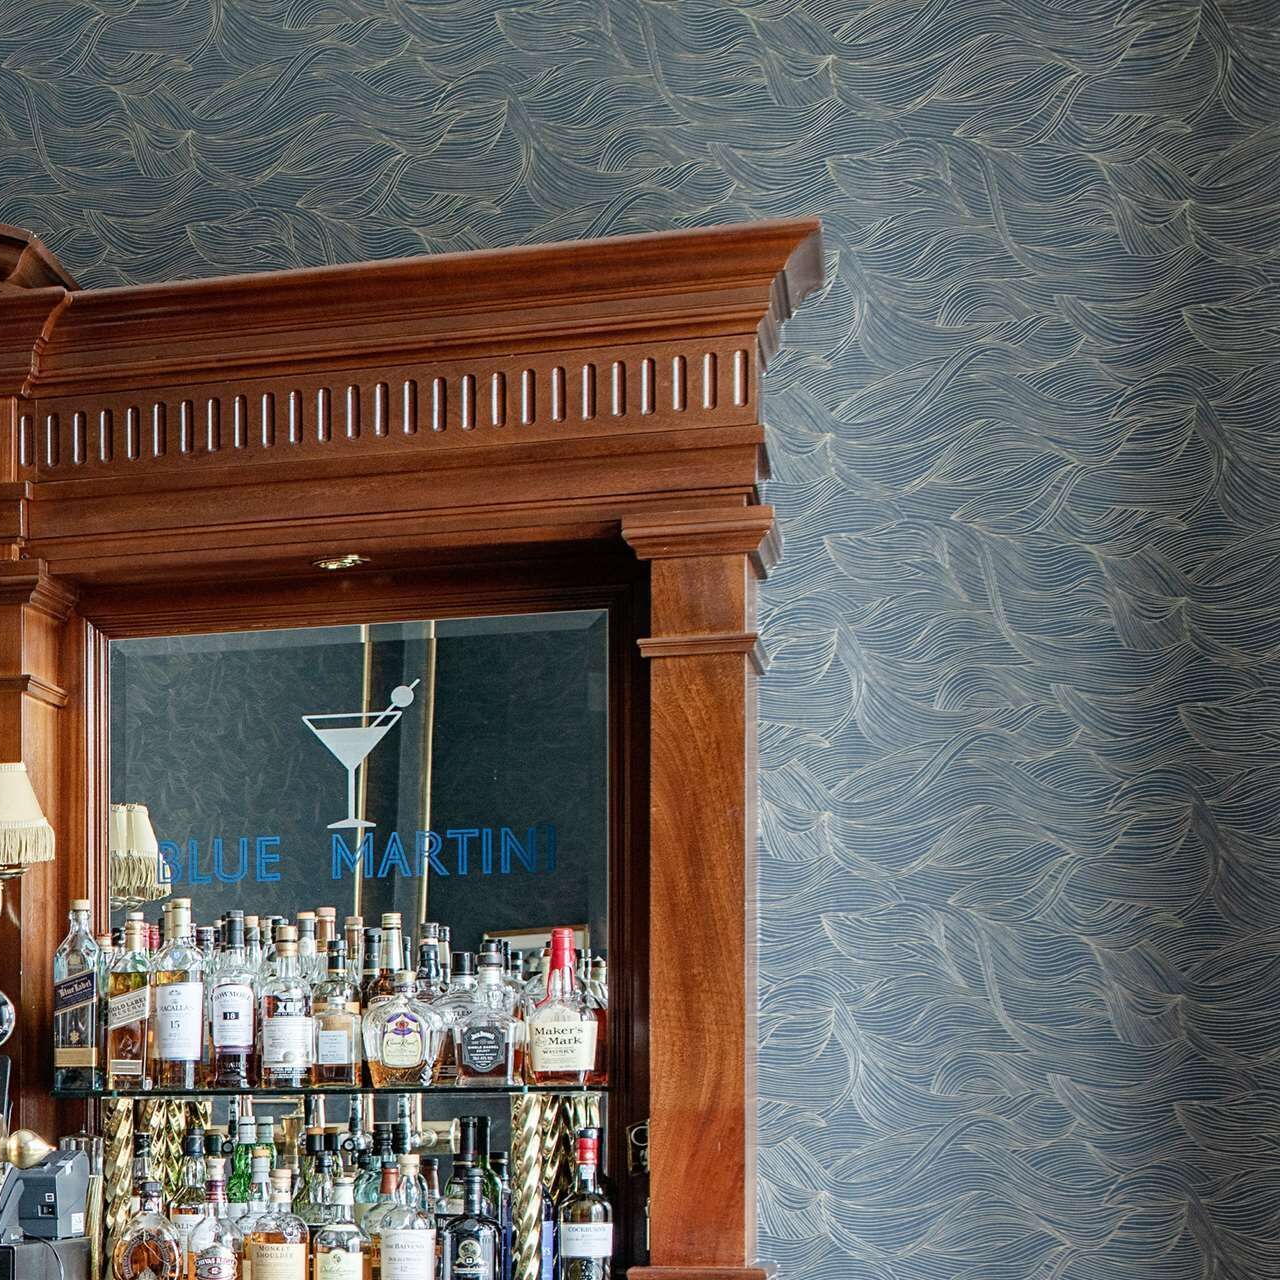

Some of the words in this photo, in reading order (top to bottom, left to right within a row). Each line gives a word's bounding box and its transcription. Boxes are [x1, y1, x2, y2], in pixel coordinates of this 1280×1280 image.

[157, 836, 280, 884] BLUE
[331, 823, 556, 879] MARTINI
[534, 1026, 584, 1036] Maker's
[549, 1036, 583, 1045] Mark
[255, 1252, 293, 1260] SHOULDER
